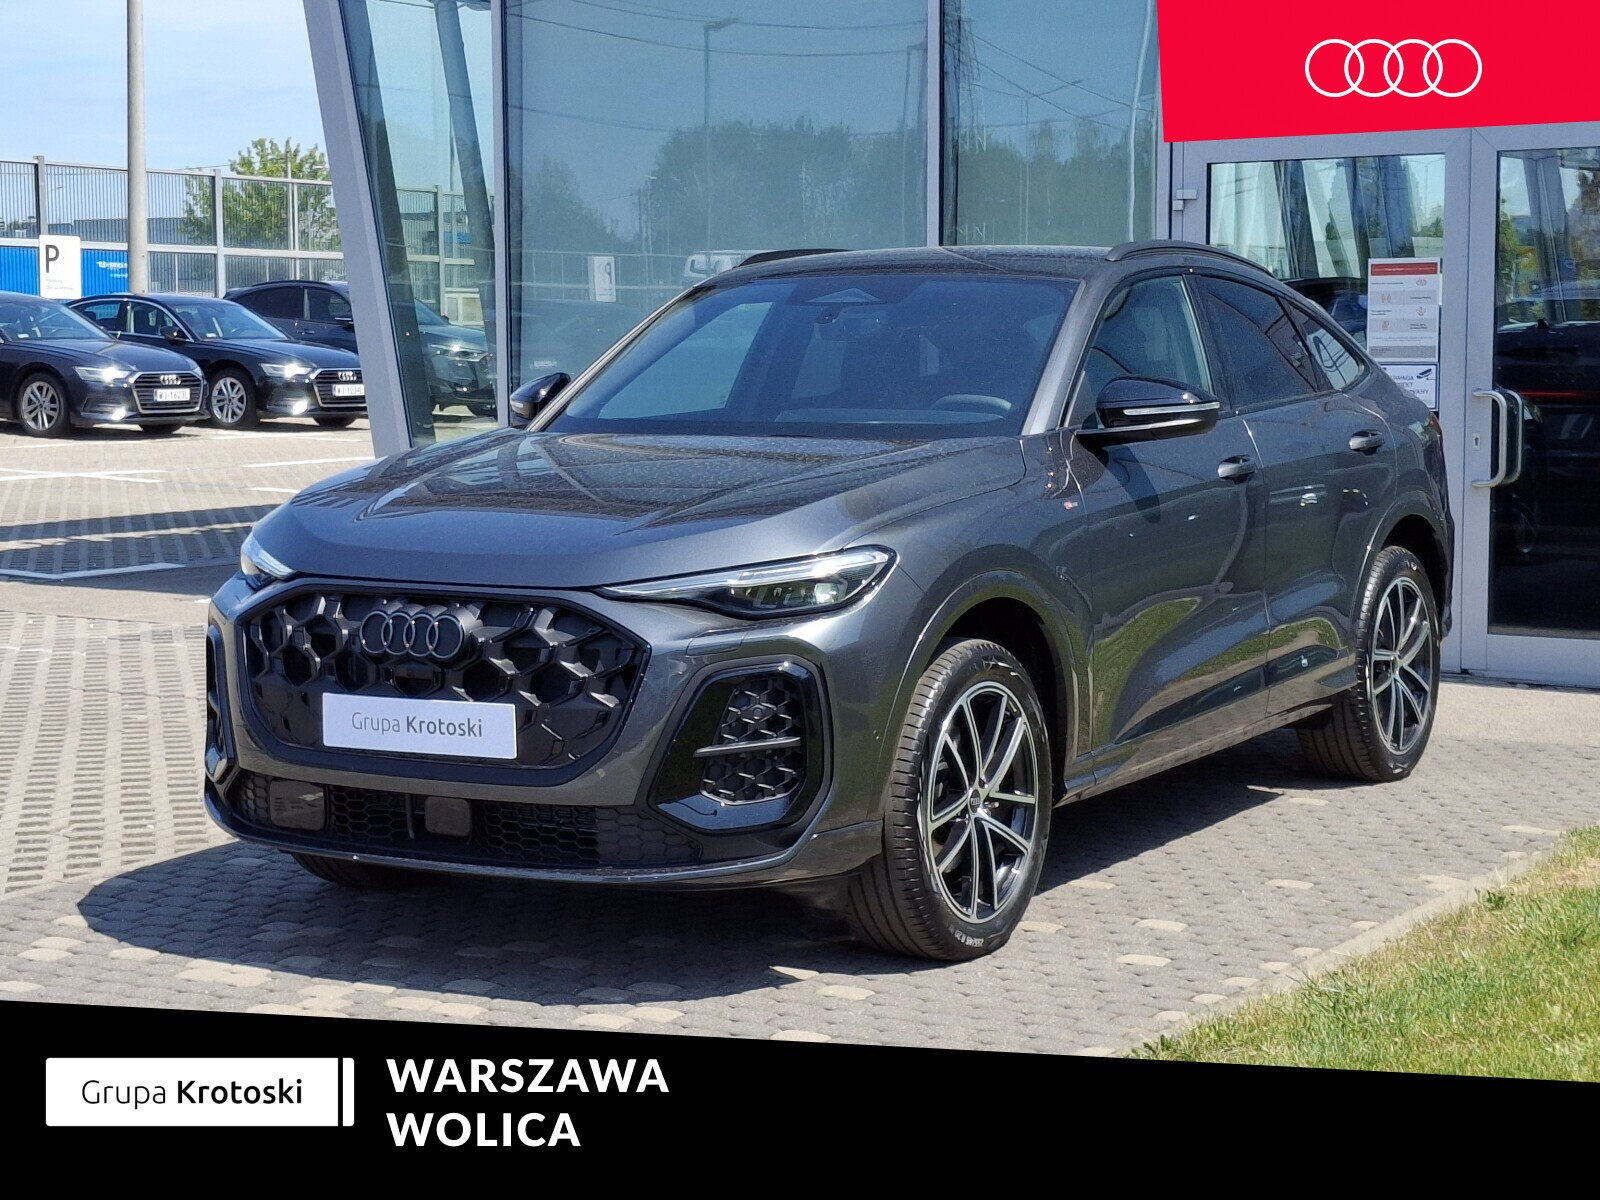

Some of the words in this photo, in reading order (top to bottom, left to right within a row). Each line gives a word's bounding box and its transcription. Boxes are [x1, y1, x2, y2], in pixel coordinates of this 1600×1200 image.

[45, 244, 60, 273] P
[351, 711, 401, 736] Grupa
[406, 715, 482, 738] Krotoski
